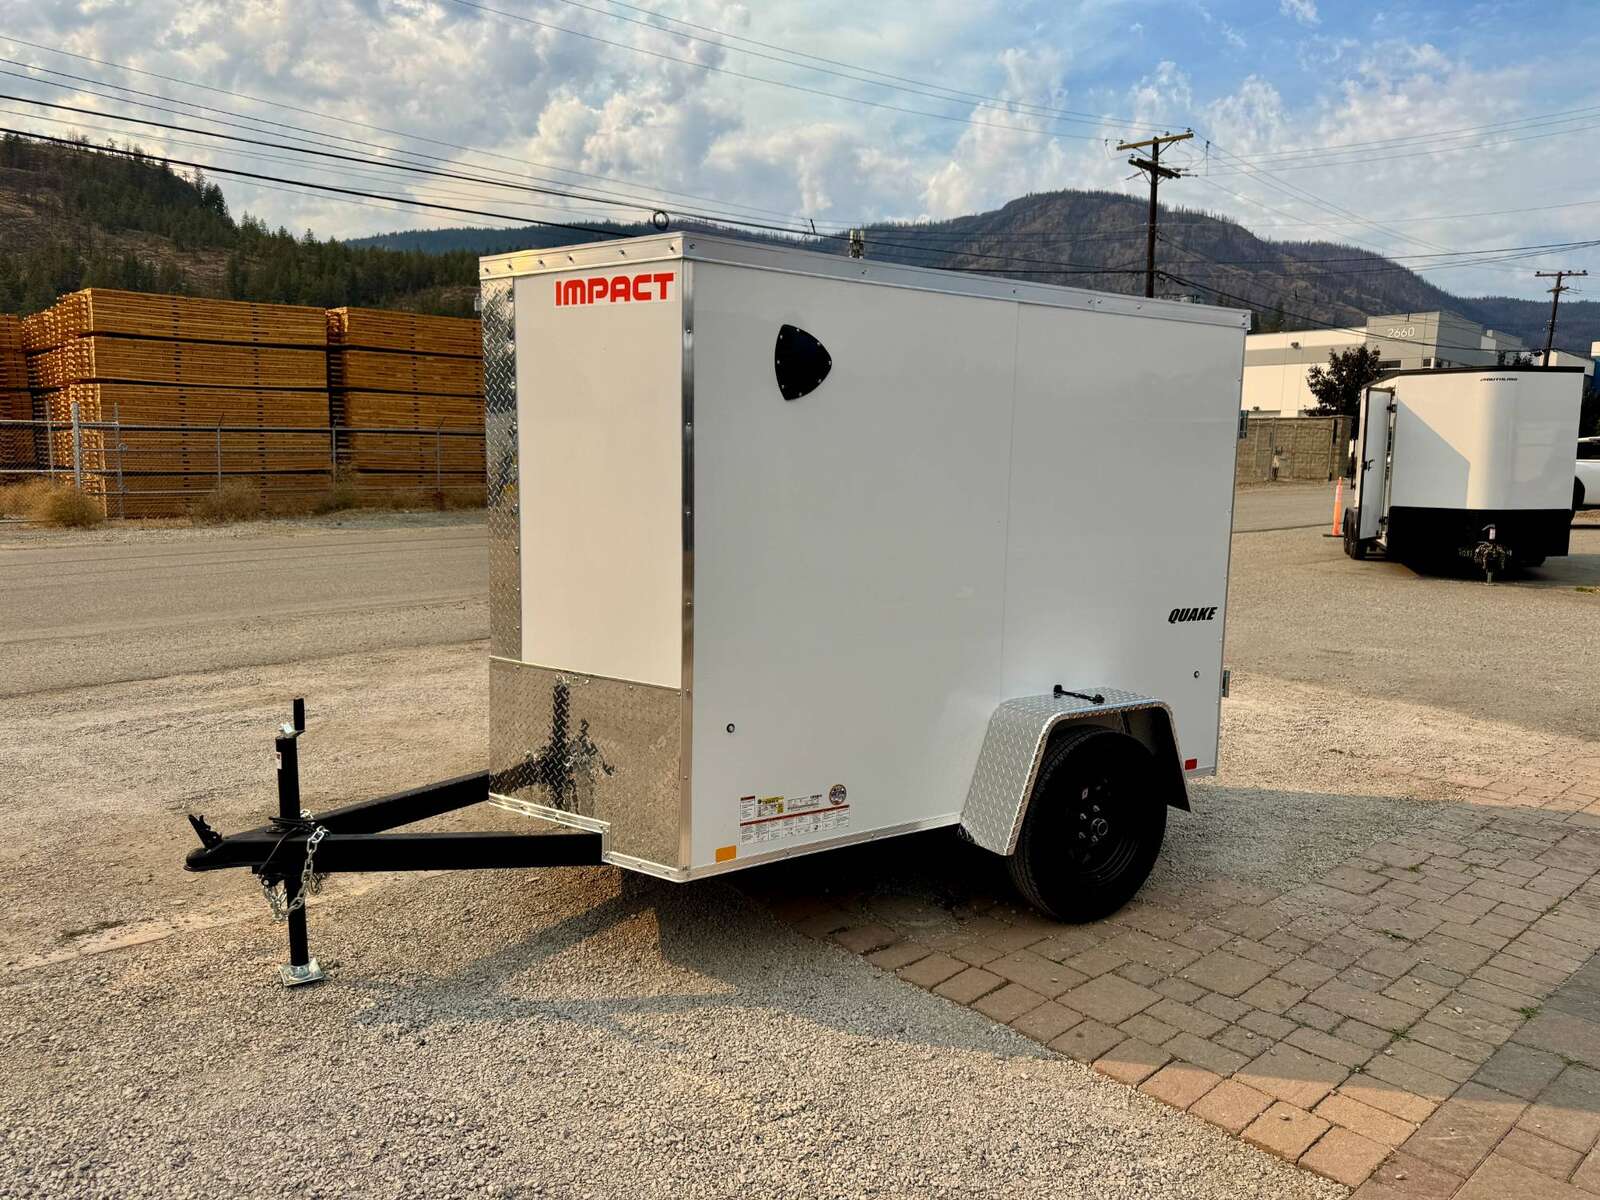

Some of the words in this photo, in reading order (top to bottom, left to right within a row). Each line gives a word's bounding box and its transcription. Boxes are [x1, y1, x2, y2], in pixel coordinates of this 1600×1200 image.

[555, 273, 674, 306] IMPACT
[1387, 327, 1415, 338] 2660
[1168, 606, 1218, 624] QUAKE
